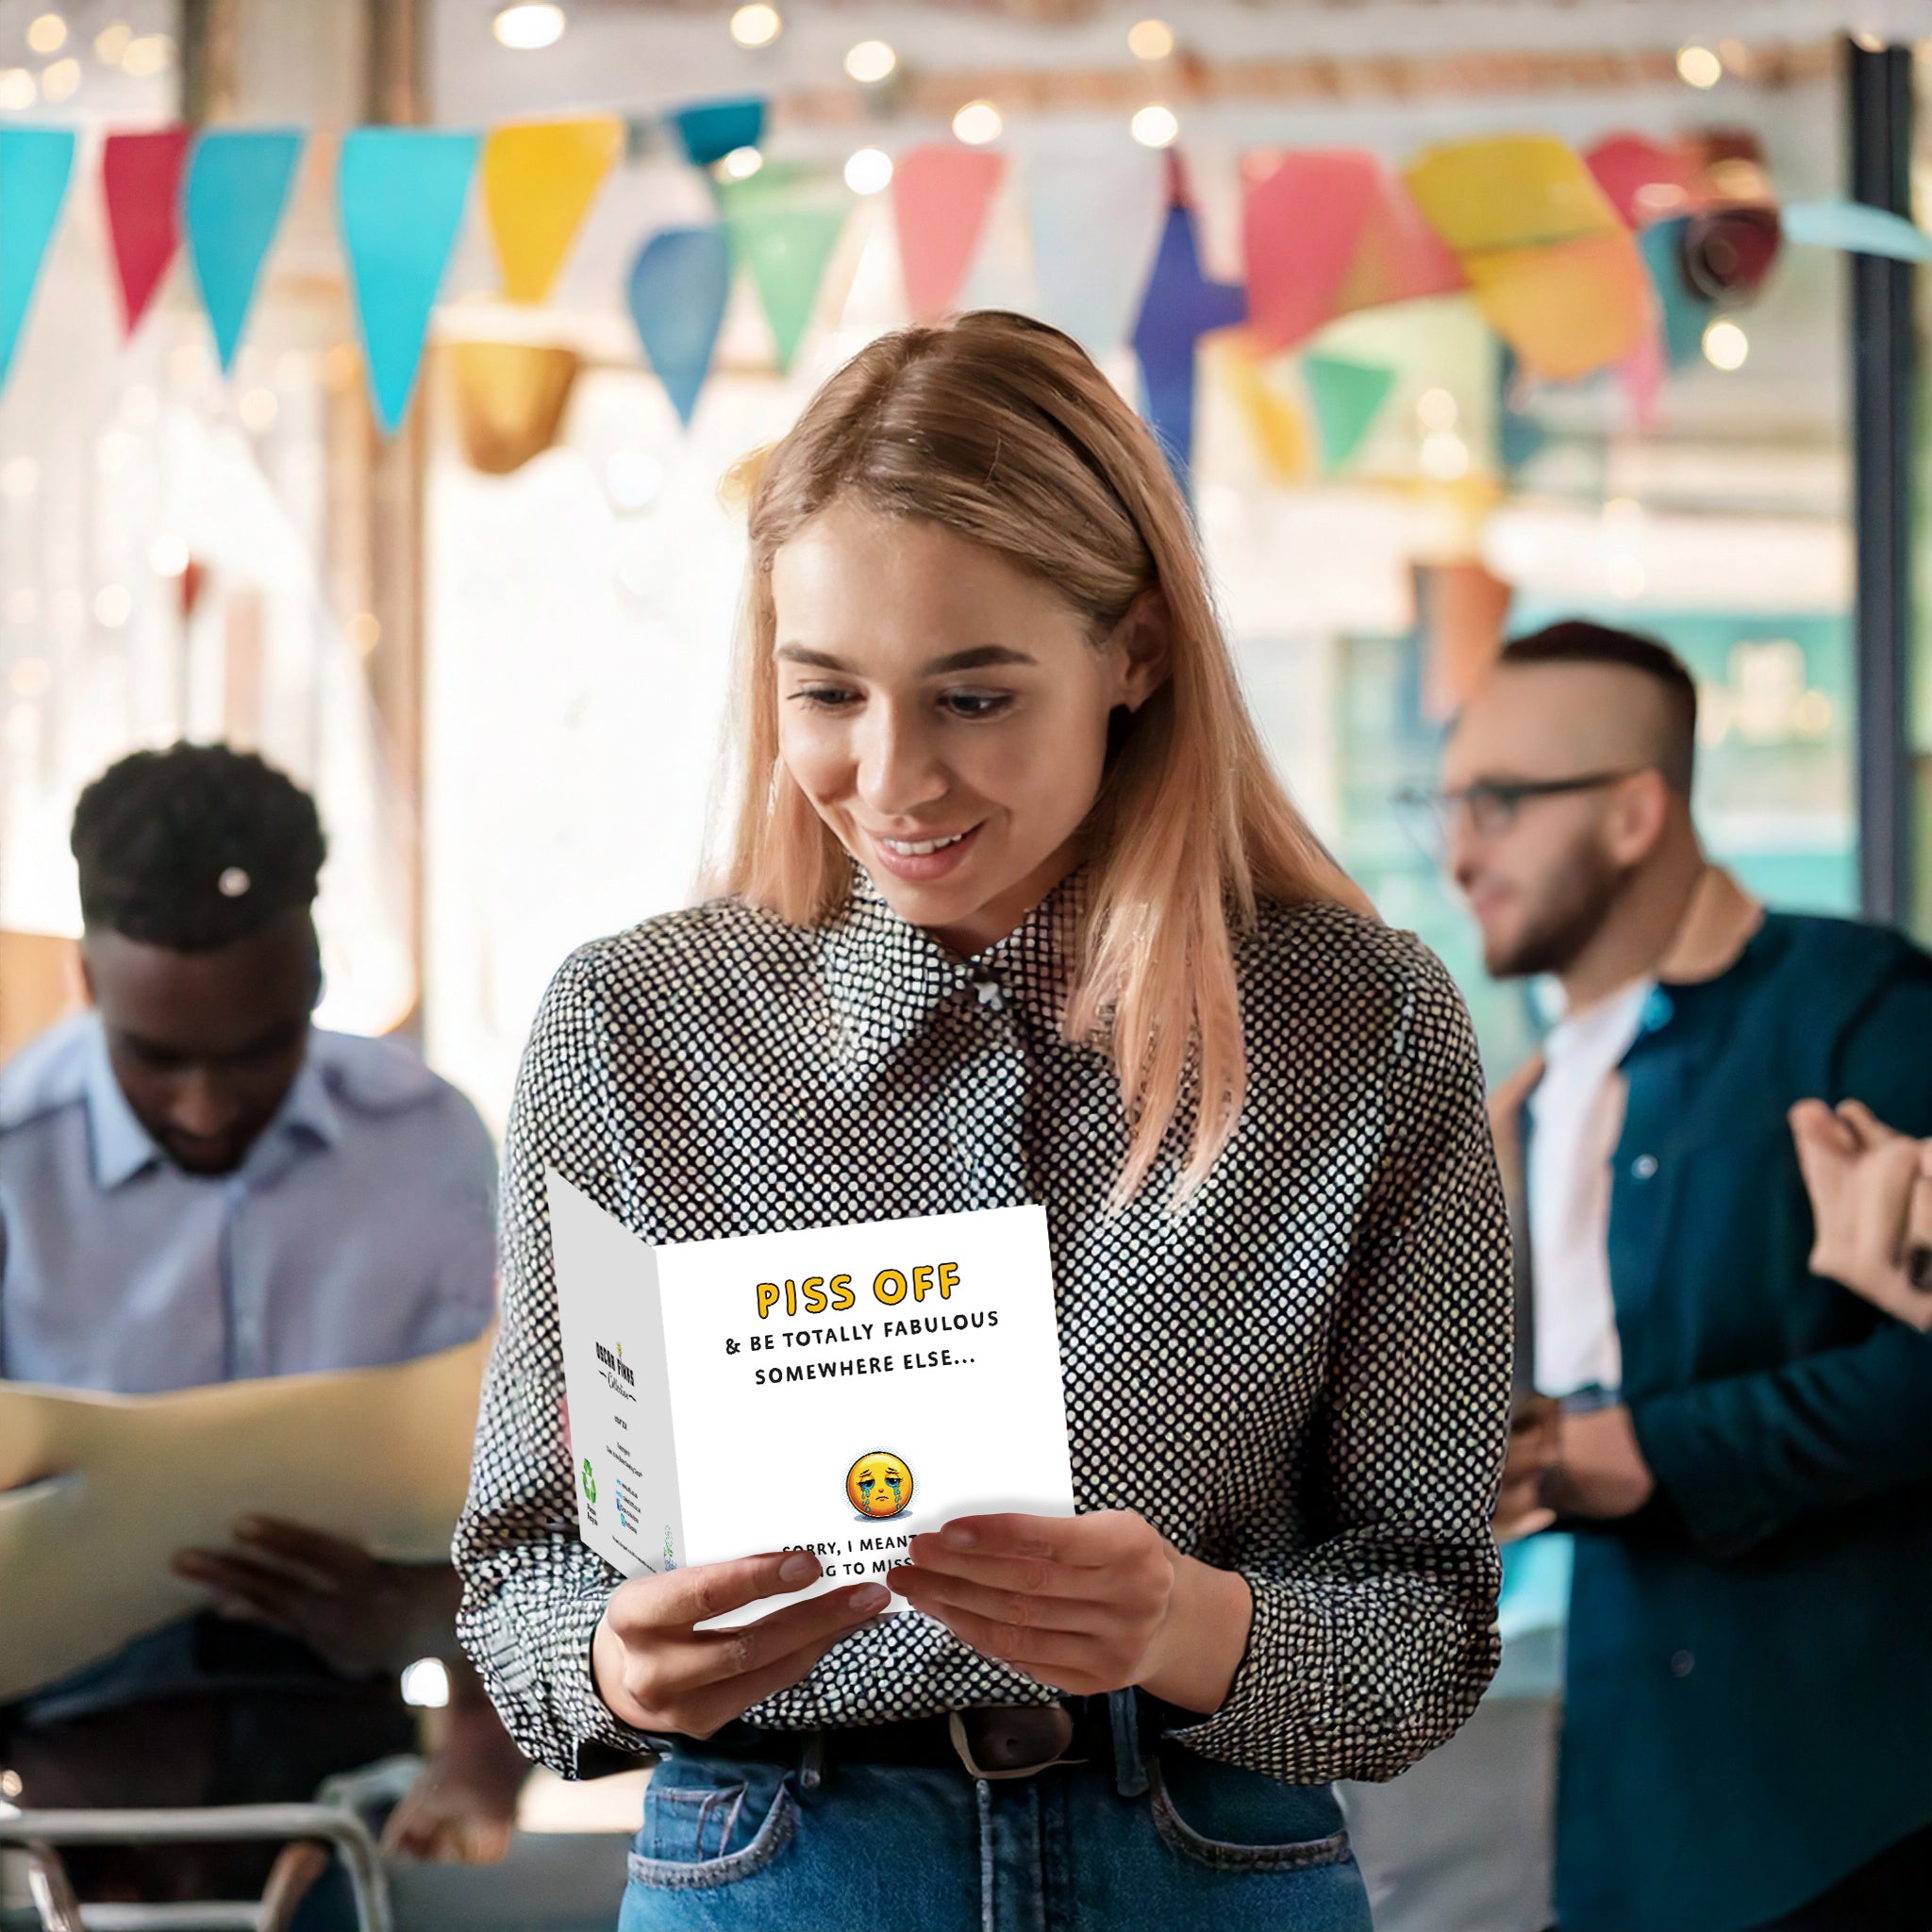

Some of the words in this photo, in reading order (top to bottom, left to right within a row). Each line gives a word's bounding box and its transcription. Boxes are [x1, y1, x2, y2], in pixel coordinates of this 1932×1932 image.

[757, 1274, 856, 1319] PISS
[874, 1262, 960, 1306] OFF
[725, 1339, 741, 1356] &
[751, 1335, 774, 1352] BE
[782, 1324, 874, 1348] TOTALLY
[884, 1311, 998, 1338] FABULOUS
[755, 1356, 894, 1385] SOMEWHERE
[903, 1350, 975, 1370] ELSE...
[848, 1540, 853, 1553] I
[843, 1561, 865, 1575] TO
